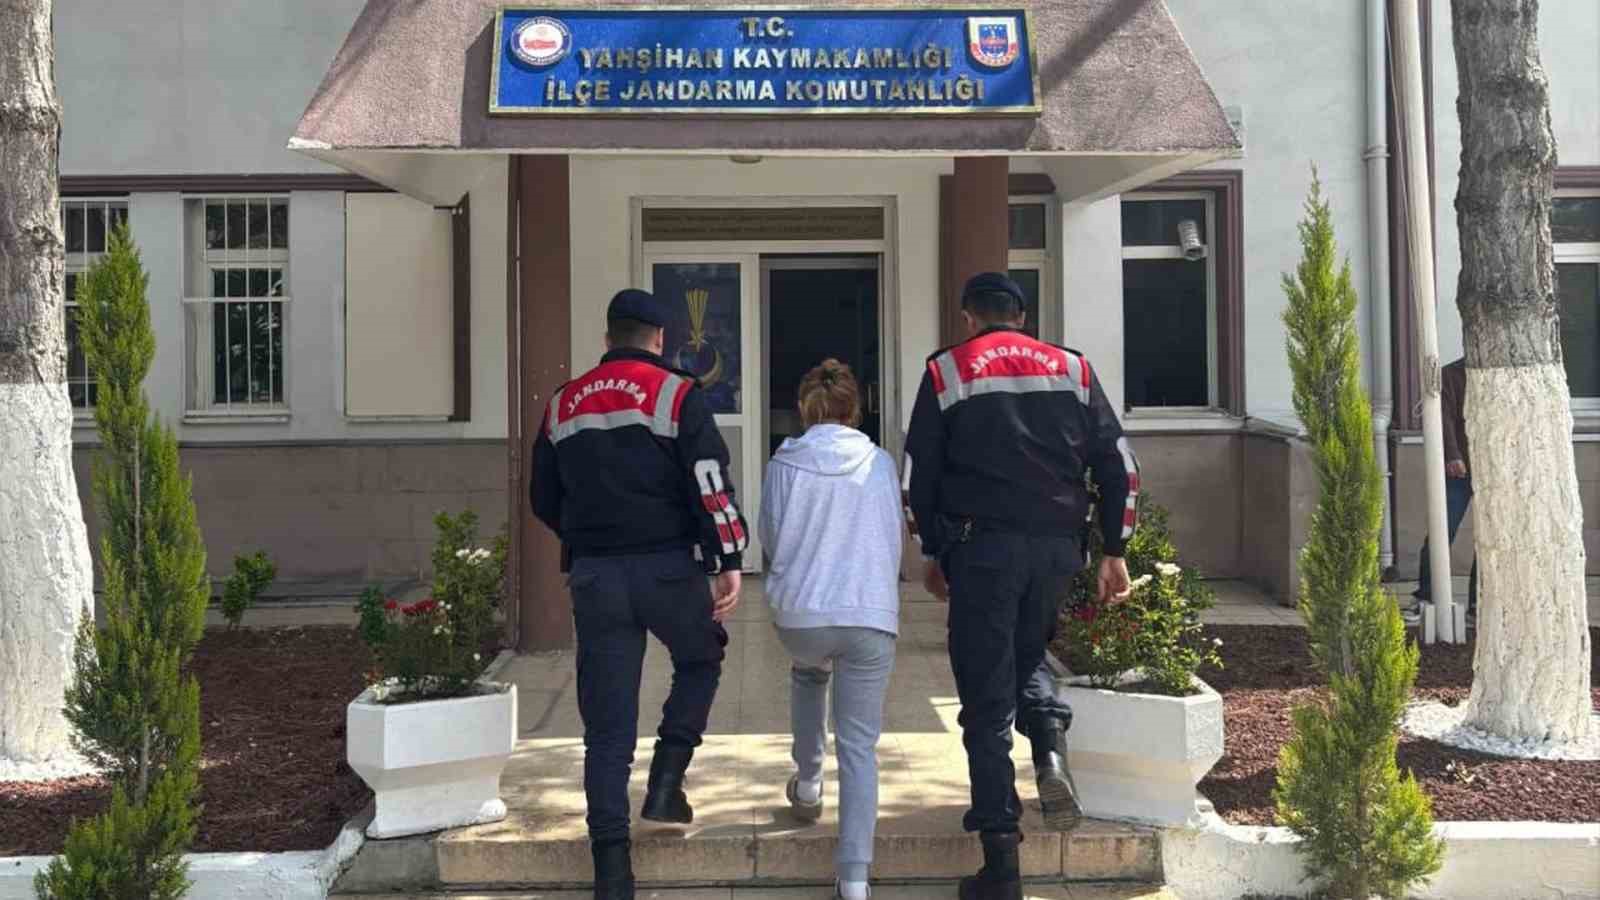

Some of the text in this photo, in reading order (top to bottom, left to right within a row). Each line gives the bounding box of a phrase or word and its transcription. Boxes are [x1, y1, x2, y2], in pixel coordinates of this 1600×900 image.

[742, 16, 794, 38] T.C.
[580, 42, 723, 73] YAHŞİHAN
[733, 43, 952, 69] KAYMAKAMLIĞI
[546, 74, 985, 106] İLÇE JANDARMA KOMUTANLIĞI
[967, 345, 1060, 375] JANDARMA
[566, 378, 648, 414] JANDARMA
